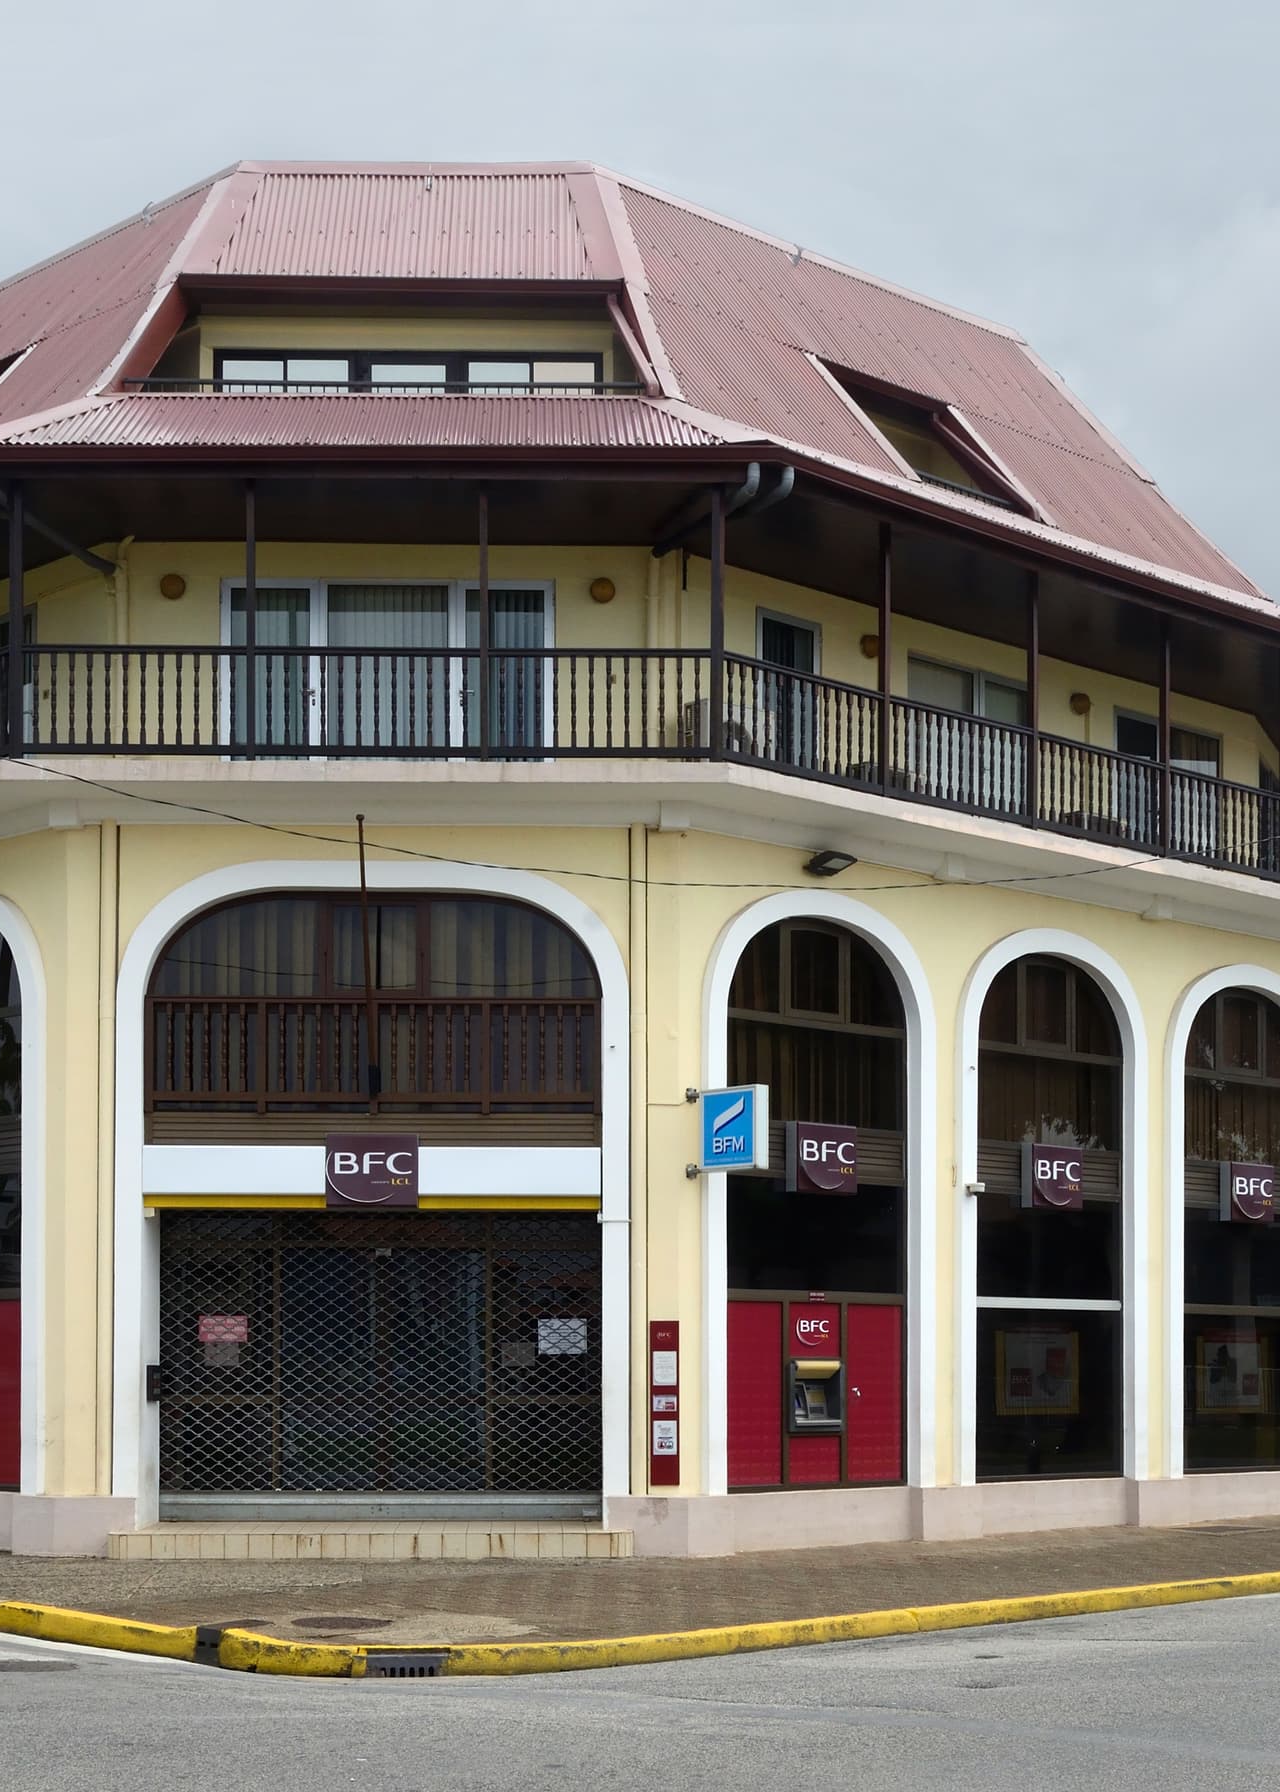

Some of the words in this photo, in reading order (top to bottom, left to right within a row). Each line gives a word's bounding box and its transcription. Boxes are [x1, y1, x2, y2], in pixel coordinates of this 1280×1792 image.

[713, 1135, 745, 1153] BFM
[803, 1139, 855, 1164] BFC
[334, 1152, 413, 1175] BFC
[1037, 1159, 1081, 1182] BFC
[391, 1177, 412, 1185] LCL
[1235, 1176, 1273, 1198] BFC
[800, 1319, 830, 1333] BFC
